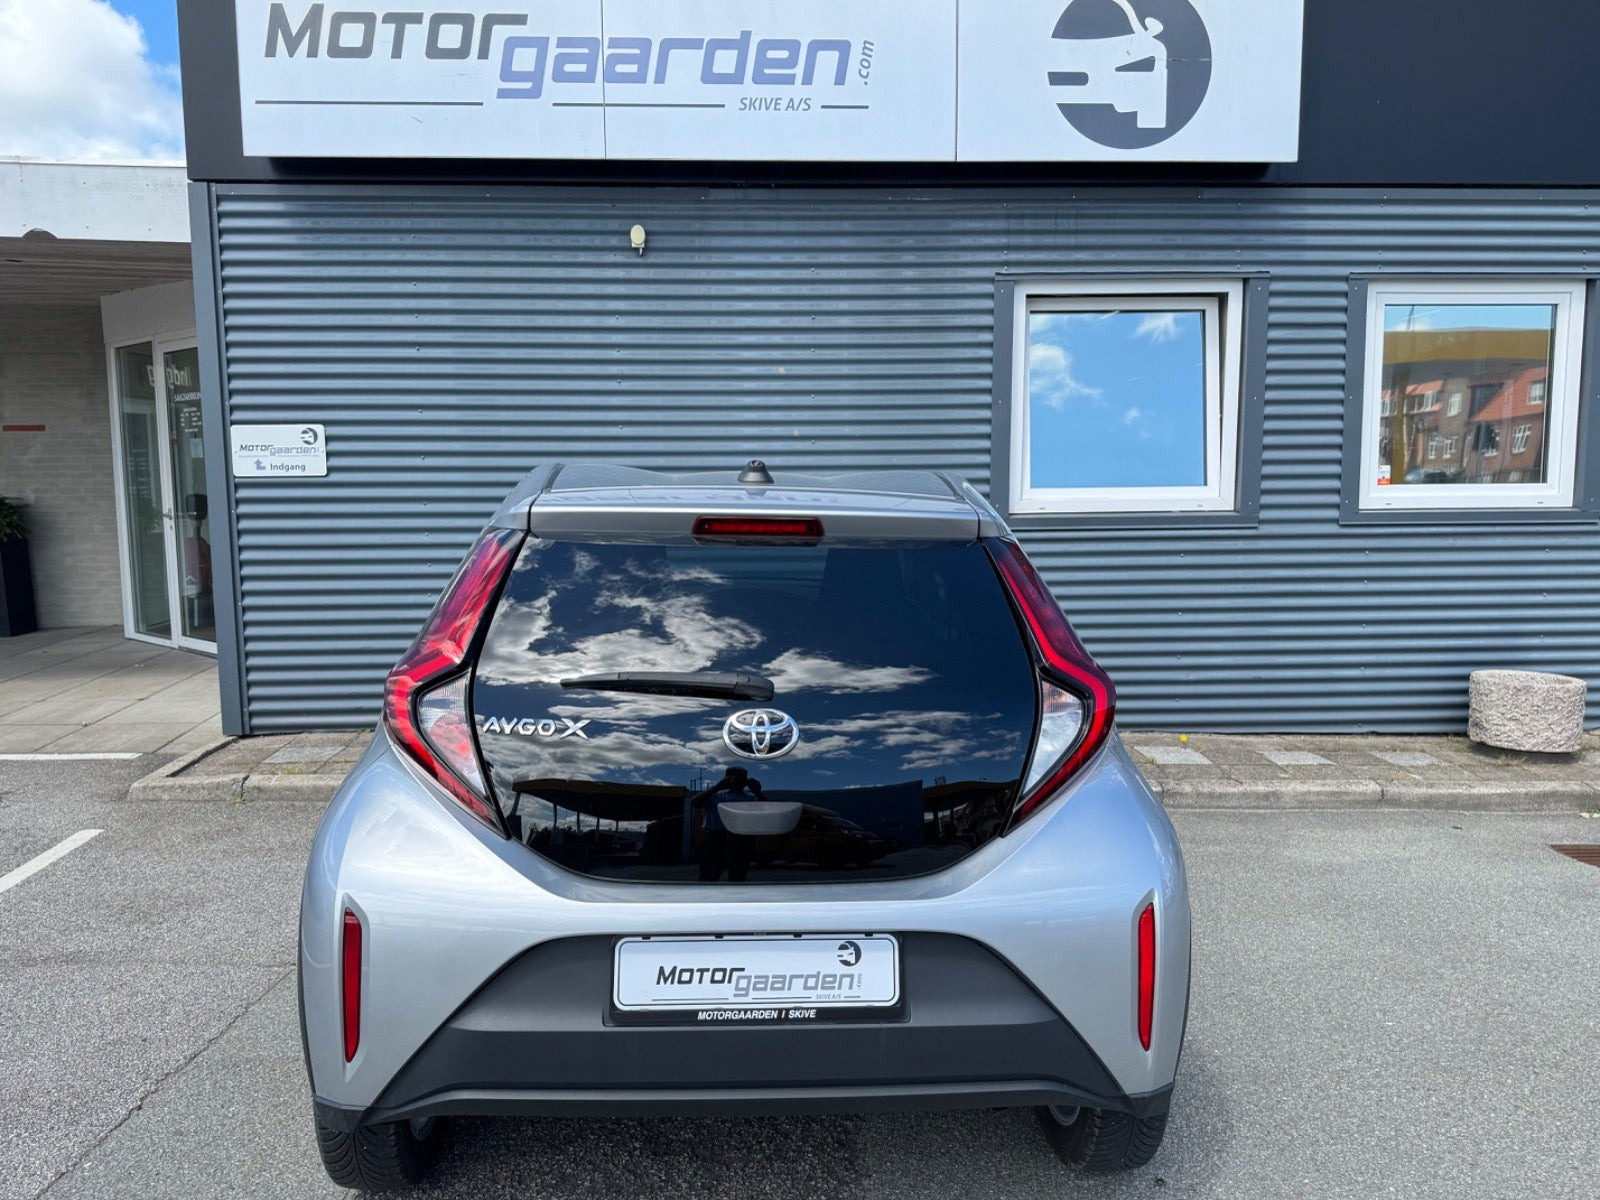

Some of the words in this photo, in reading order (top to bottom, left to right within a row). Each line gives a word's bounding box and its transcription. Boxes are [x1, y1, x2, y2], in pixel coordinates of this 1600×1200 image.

[738, 97, 782, 111] SKIVE
[785, 97, 812, 111] A/S
[270, 463, 306, 472] Indgang
[697, 1010, 779, 1021] MOTORGAARDEN
[788, 1009, 817, 1019] SKIVE
